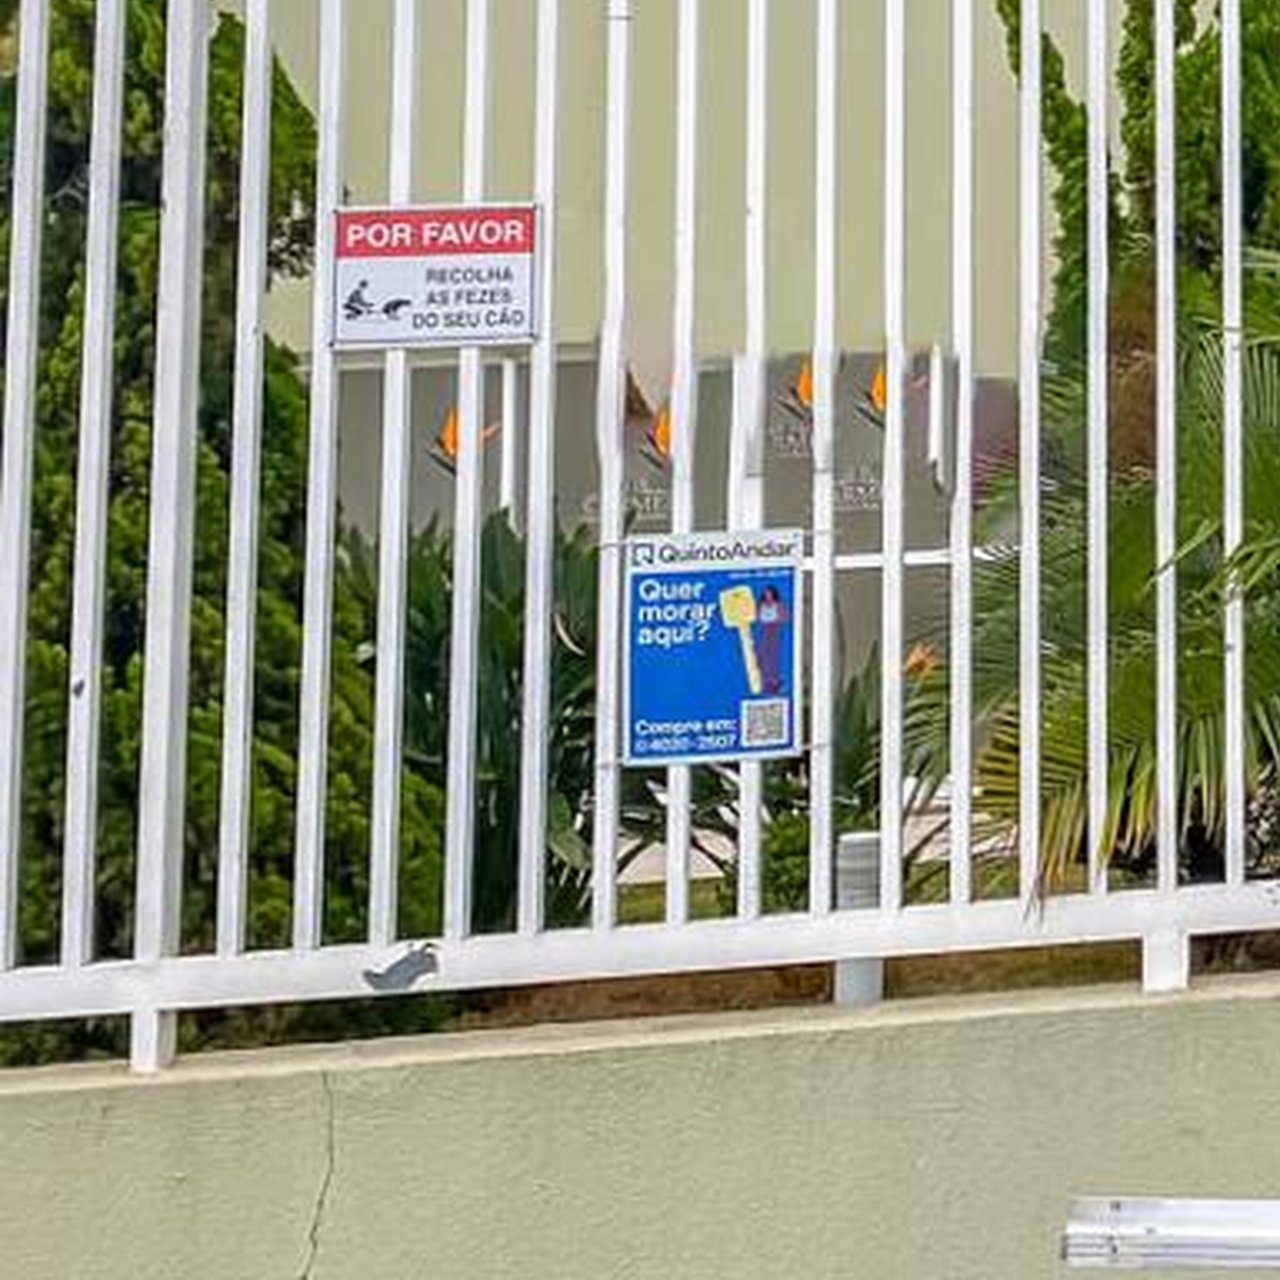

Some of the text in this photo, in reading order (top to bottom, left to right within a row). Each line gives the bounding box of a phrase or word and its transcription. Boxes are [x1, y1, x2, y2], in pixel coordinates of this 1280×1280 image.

[346, 219, 525, 248] POR FAVOR
[425, 266, 514, 283] RECOLHA
[425, 286, 513, 305] AS FEZES
[412, 306, 525, 329] DO SEU CÃO
[659, 541, 794, 564] QuintoAndar
[638, 579, 706, 601] Quer
[638, 602, 716, 622] morar
[638, 621, 710, 649] aqui?
